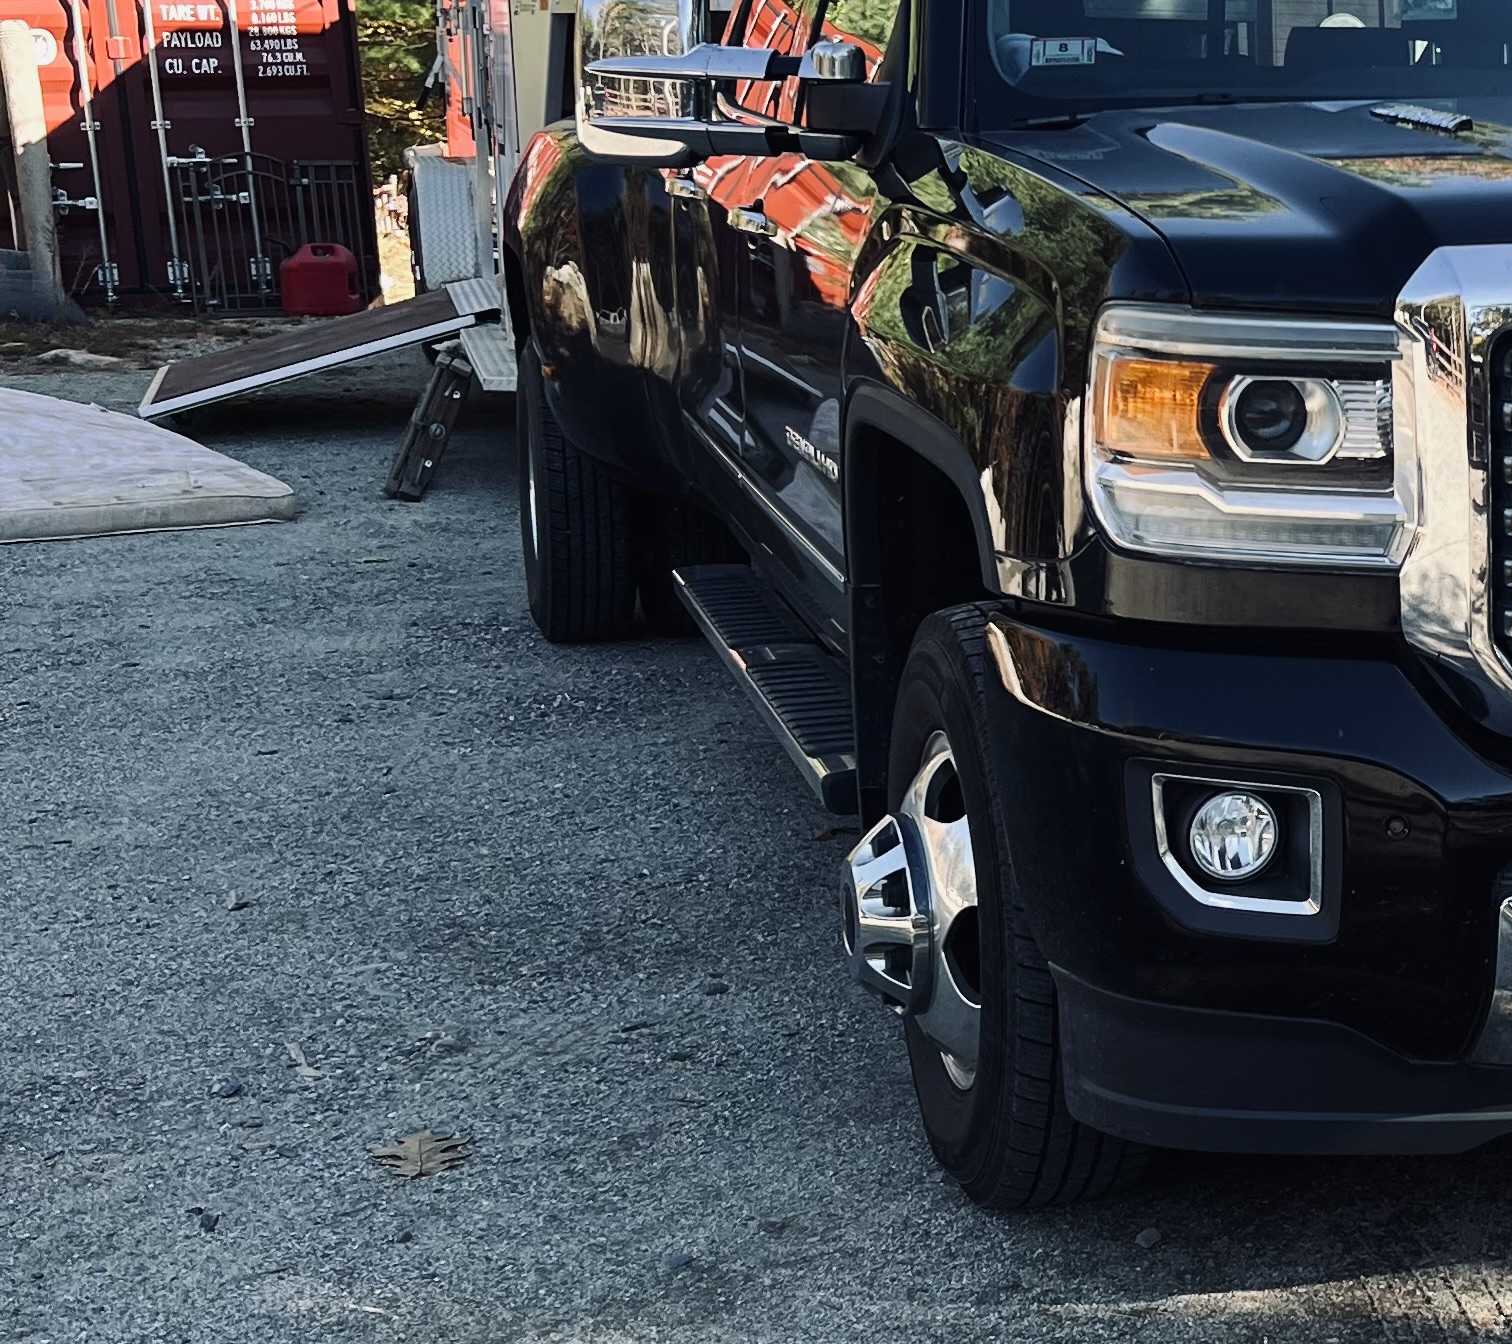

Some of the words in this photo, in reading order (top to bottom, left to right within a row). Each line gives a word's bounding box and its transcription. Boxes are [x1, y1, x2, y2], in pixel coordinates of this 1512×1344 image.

[160, 4, 196, 21] TARE
[279, 25, 297, 36] KGS
[162, 31, 222, 48] PAYLOAD
[281, 39, 299, 50] LBS
[165, 58, 187, 74] CU.
[191, 58, 222, 74] CAP.
